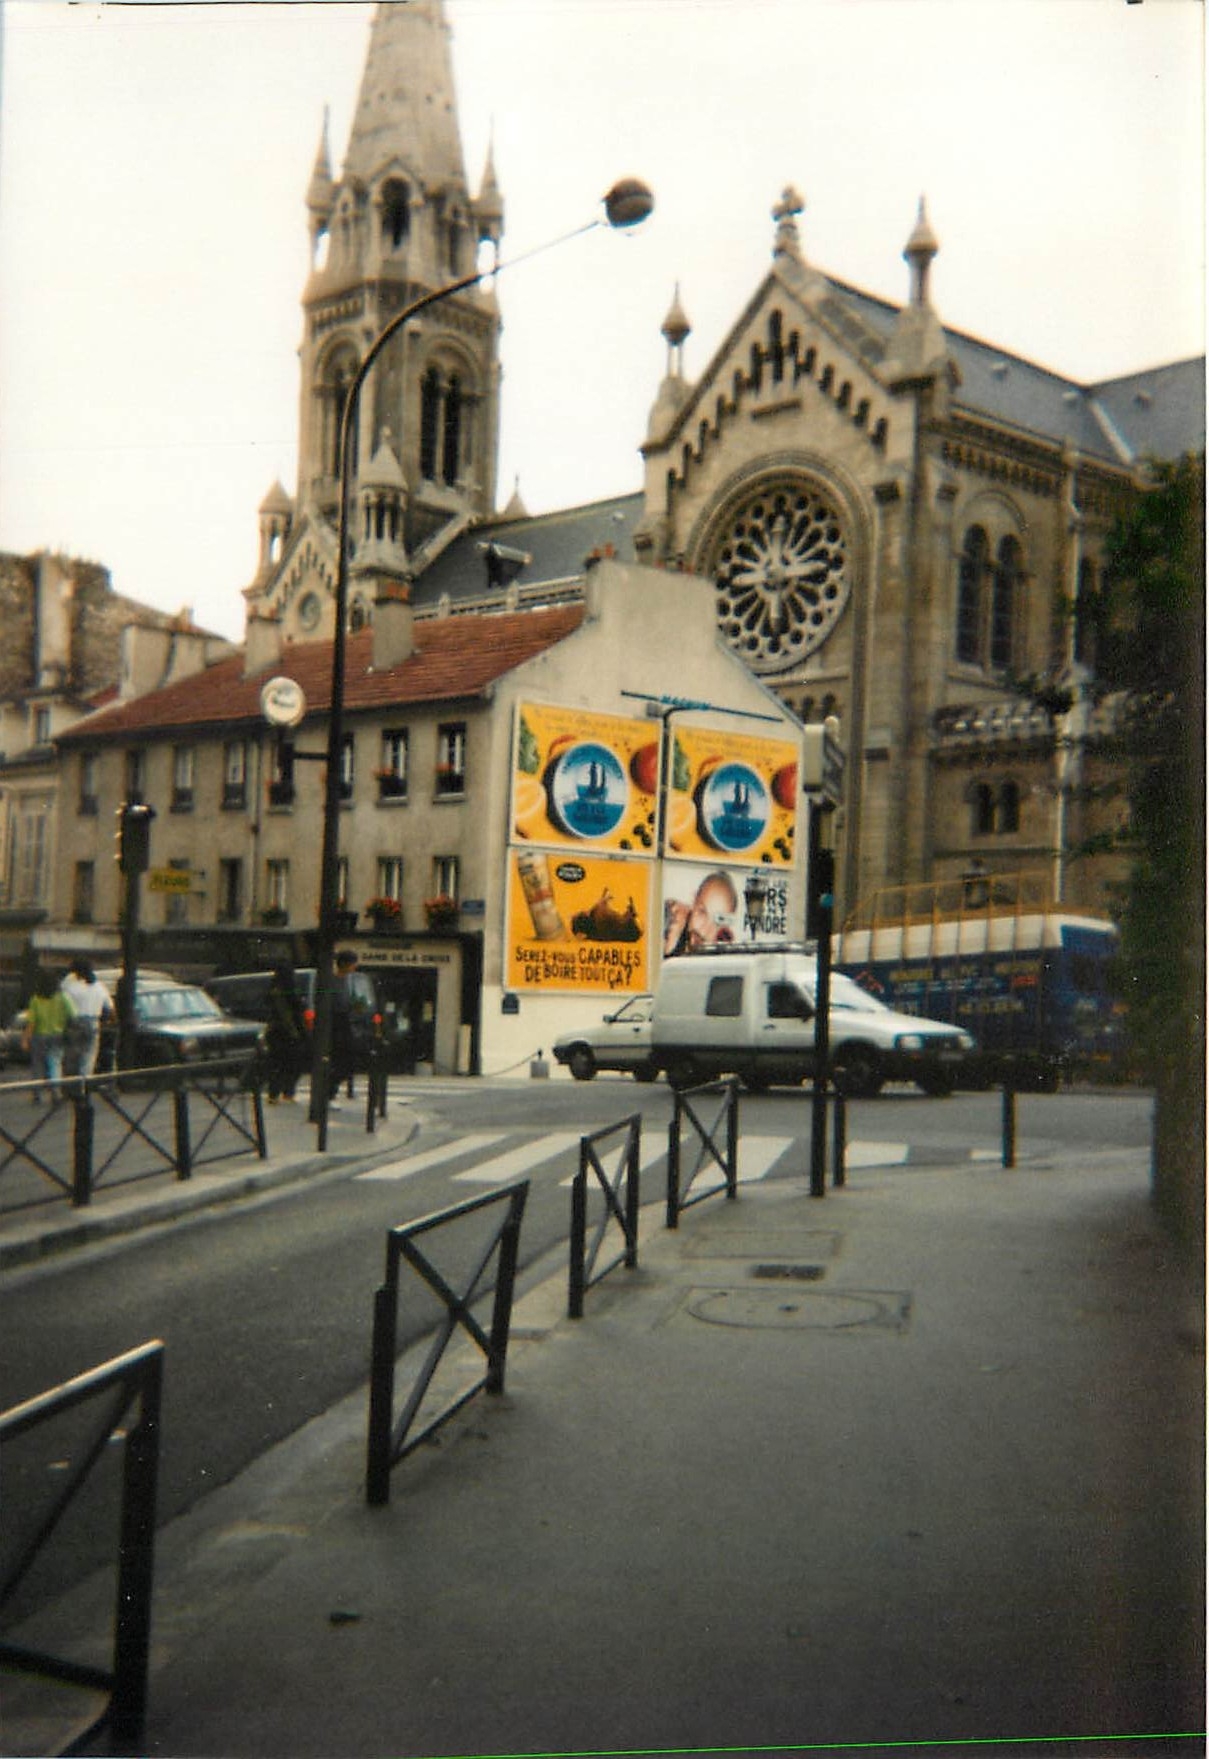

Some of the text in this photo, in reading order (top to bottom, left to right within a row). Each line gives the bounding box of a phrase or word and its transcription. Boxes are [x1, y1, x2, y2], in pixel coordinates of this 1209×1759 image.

[744, 914, 787, 935] PNDRE
[578, 948, 641, 967] CAPABLES
[525, 965, 541, 982] DE
[544, 963, 577, 980] BOIRE
[580, 966, 605, 982] TOUT
